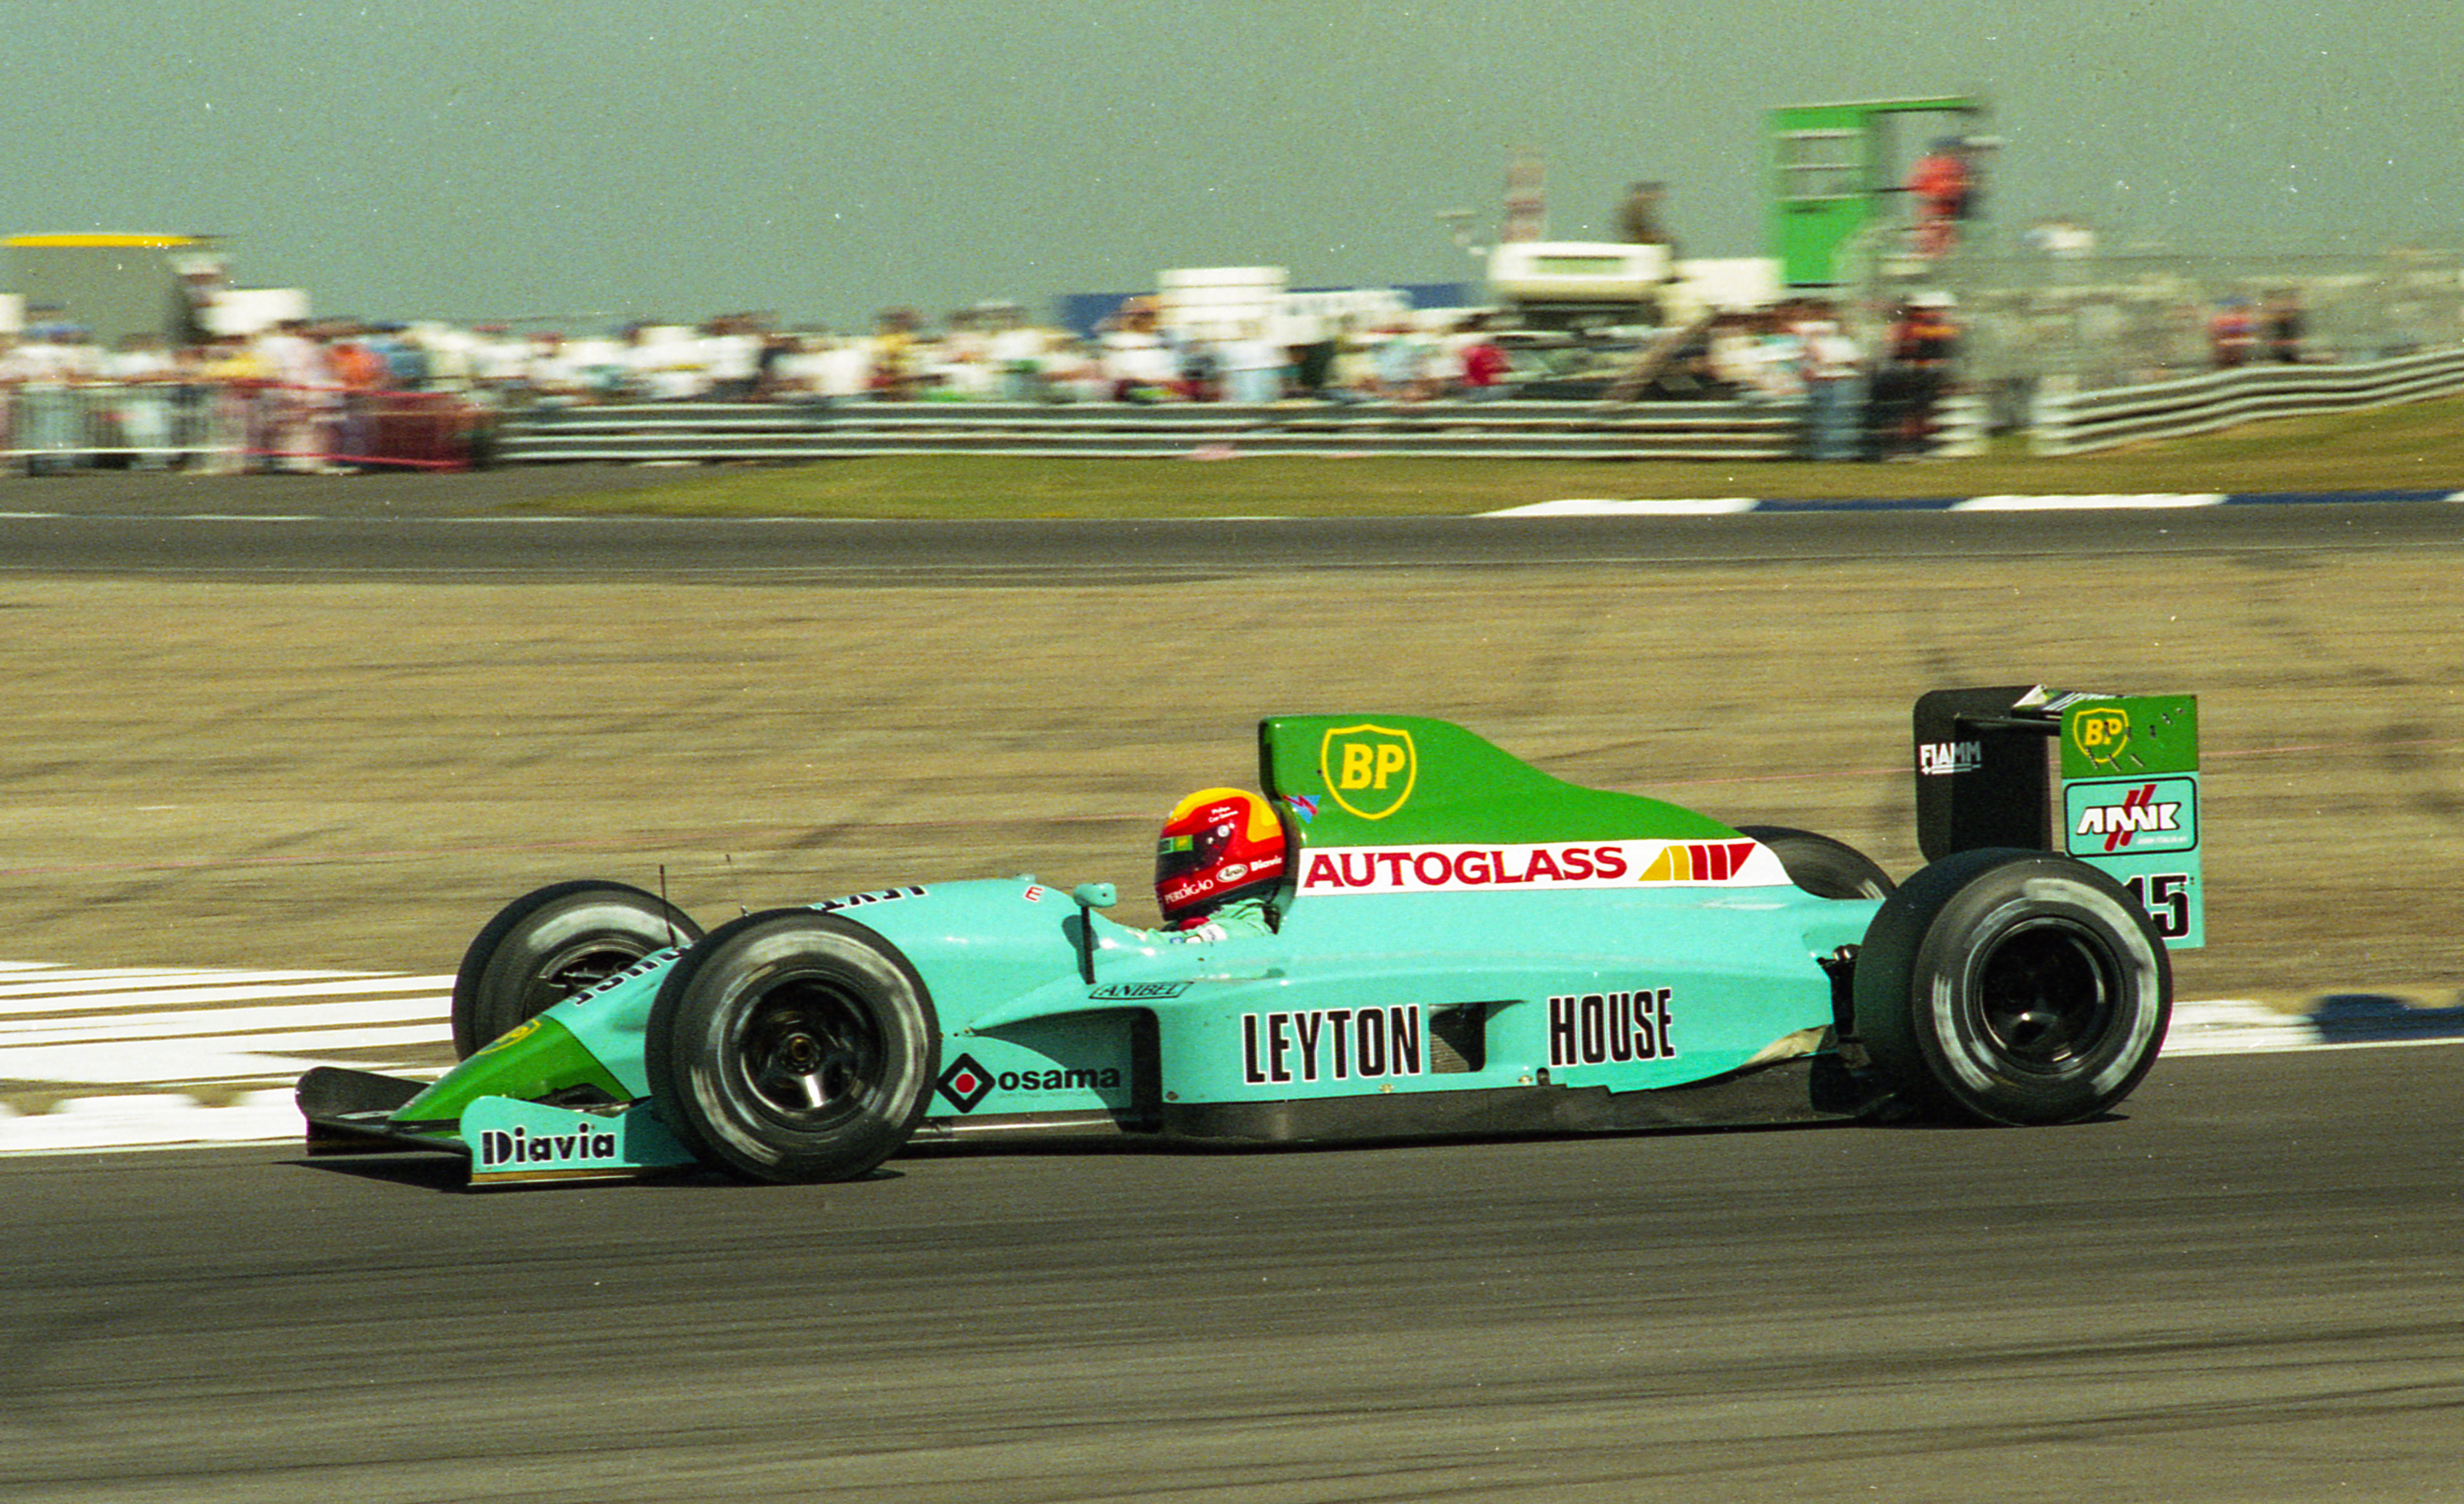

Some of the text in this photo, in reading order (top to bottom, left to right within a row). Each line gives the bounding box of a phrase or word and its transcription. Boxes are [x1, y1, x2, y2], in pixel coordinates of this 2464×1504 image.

[2084, 719, 2122, 746] BP
[1341, 744, 1405, 789] BP
[1920, 742, 1981, 765] FIAMM
[1304, 847, 1627, 888] AUTOGLASS
[1242, 988, 1675, 1085] LEYTON HOUSE
[999, 1067, 1120, 1090] osama
[482, 1123, 615, 1165] Diavia
